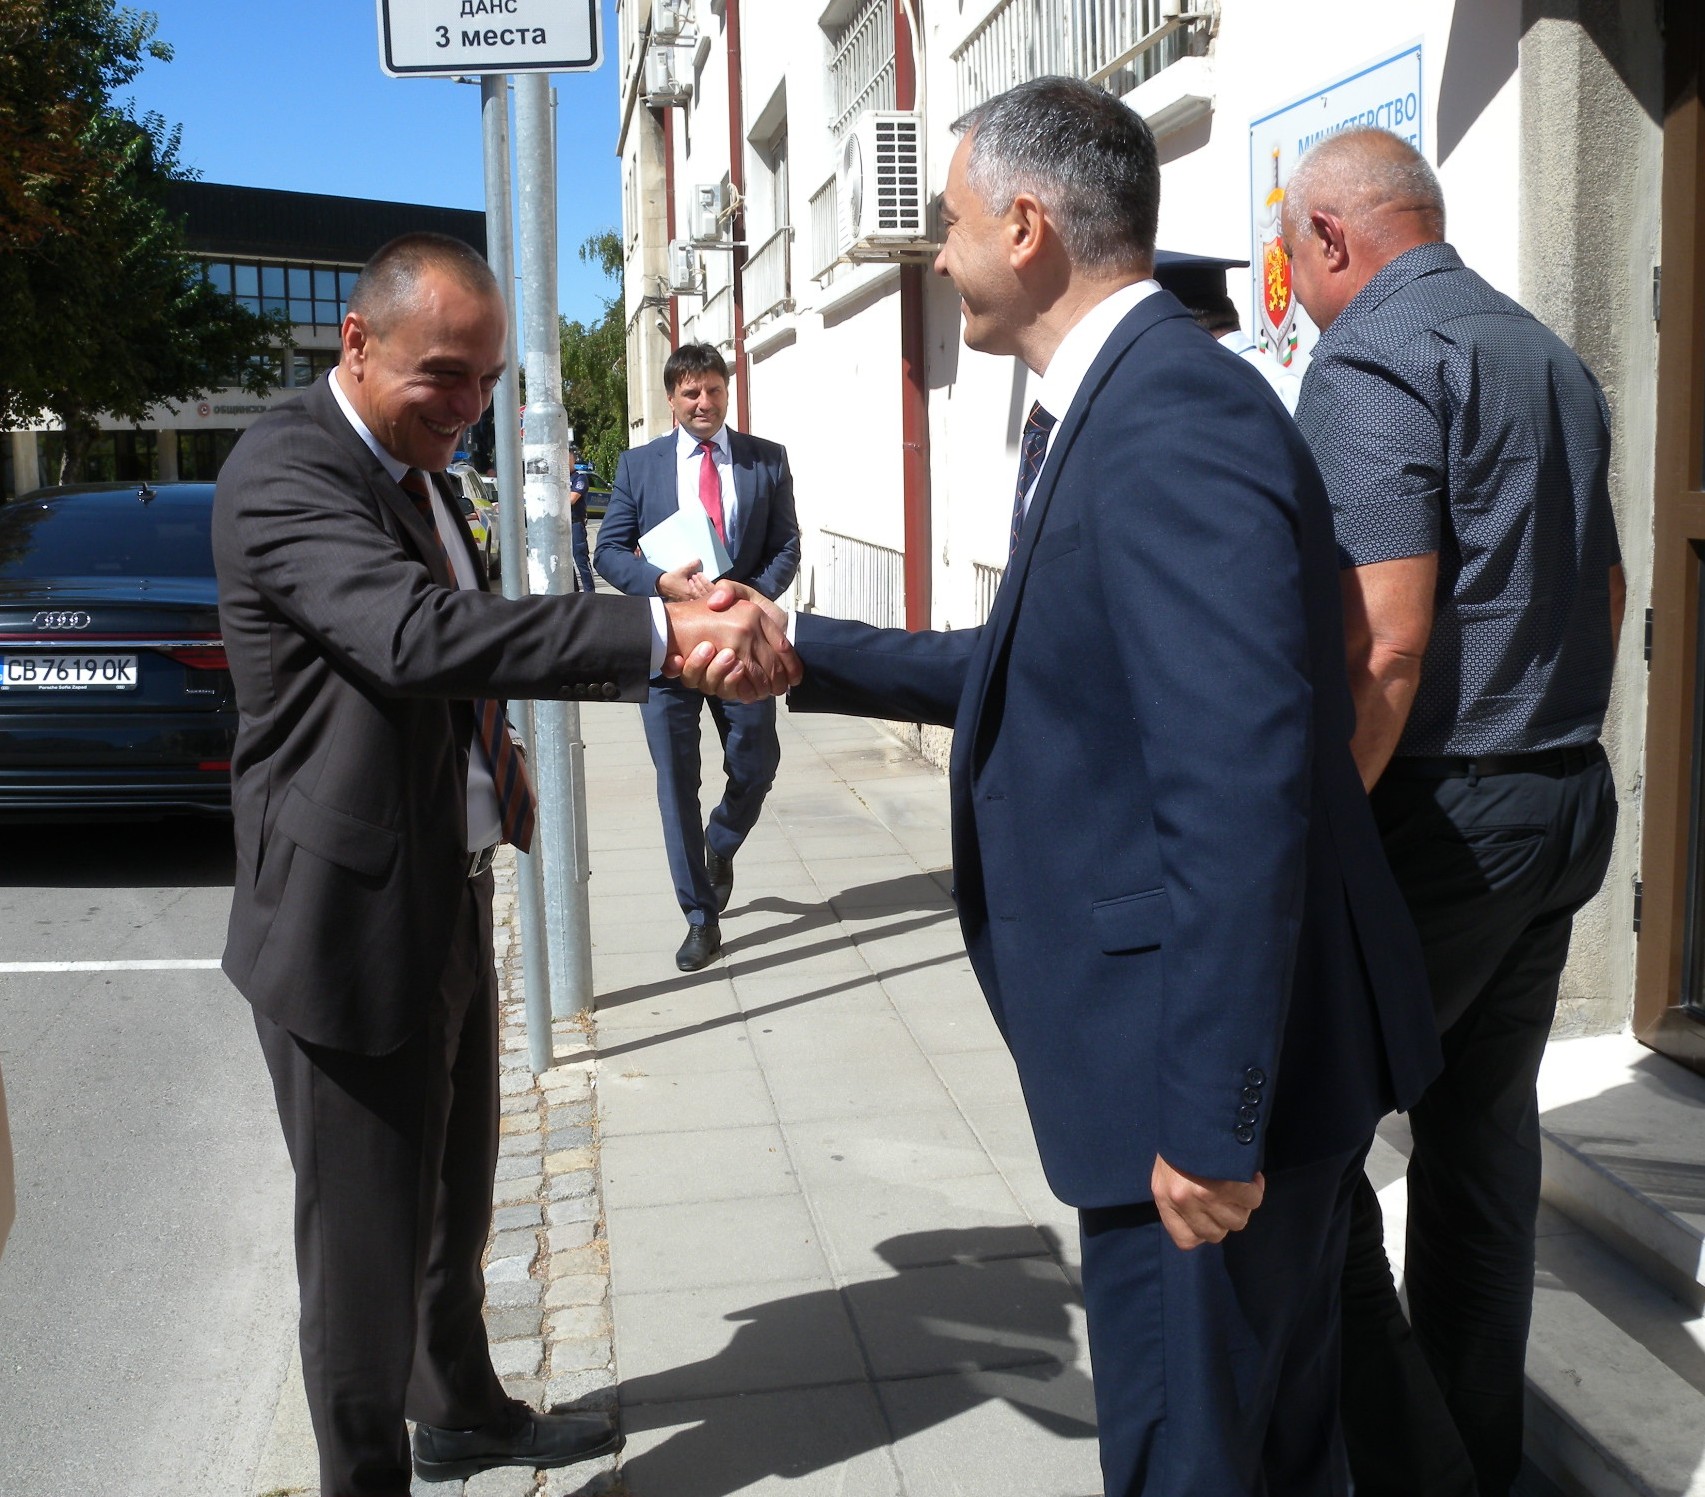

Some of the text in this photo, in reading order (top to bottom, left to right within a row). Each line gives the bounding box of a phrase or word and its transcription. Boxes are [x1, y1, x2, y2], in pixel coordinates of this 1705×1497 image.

[460, 0, 518, 18] ДАНС
[435, 25, 547, 48] 3 места
